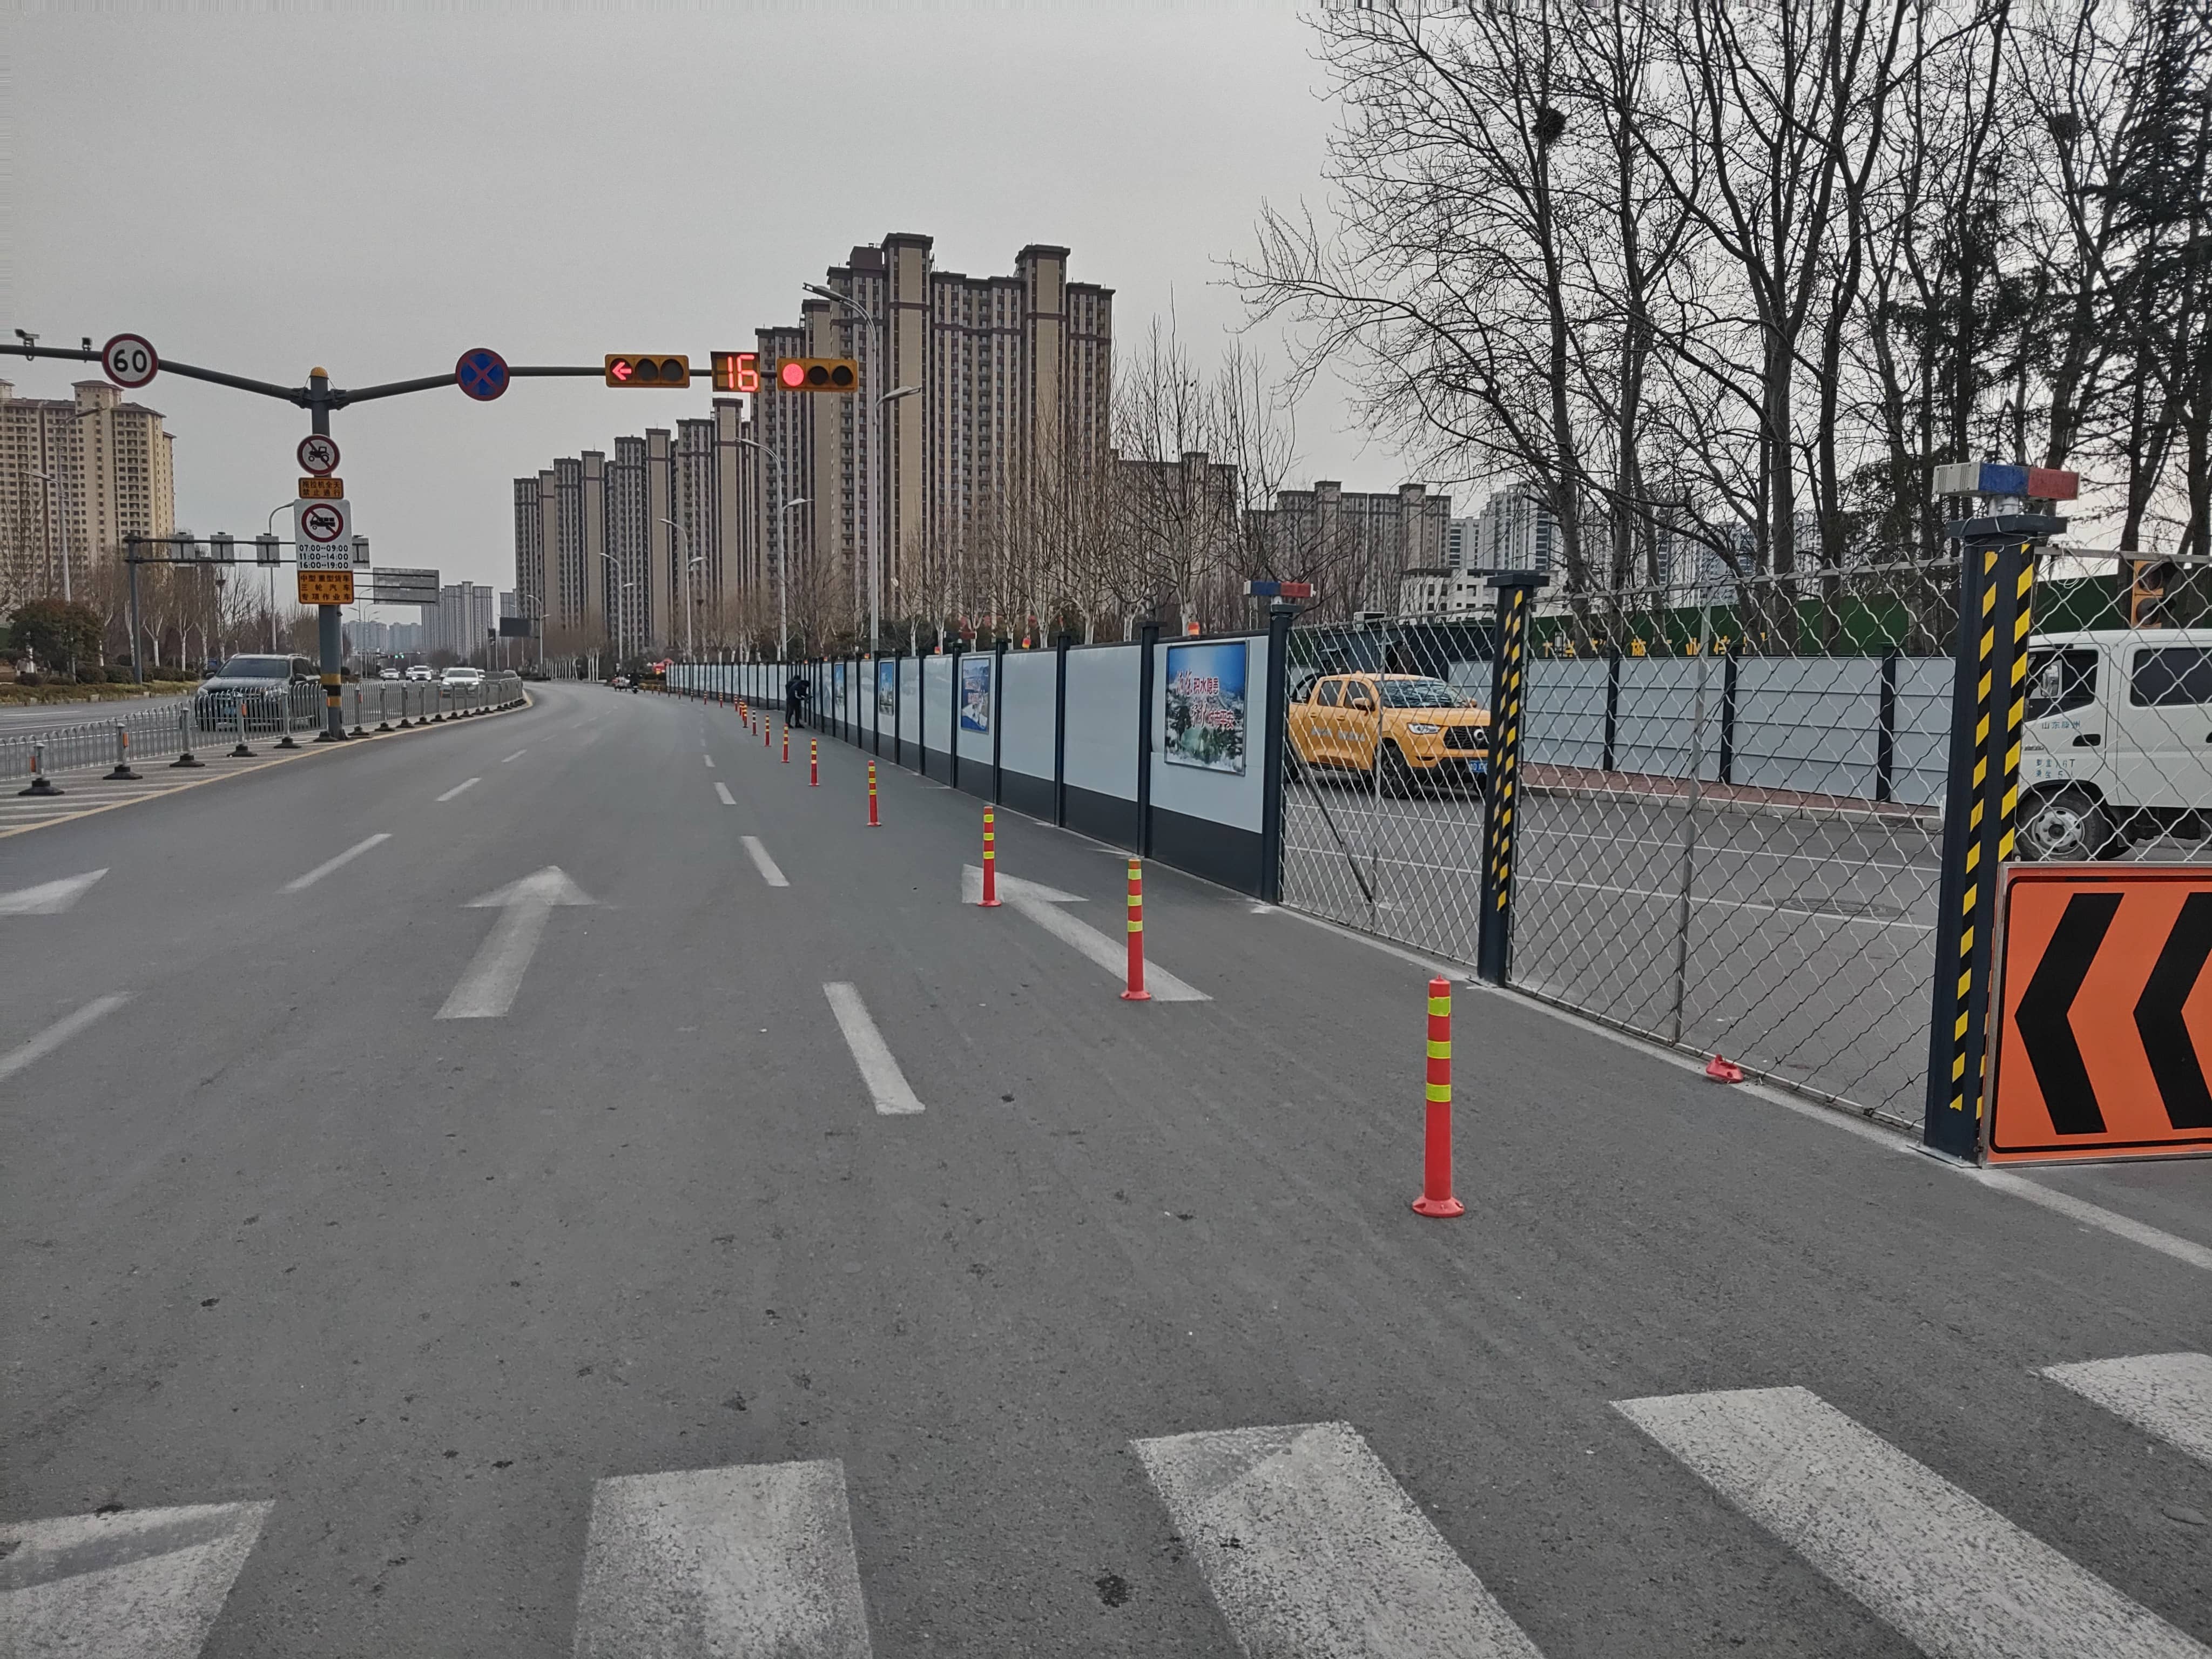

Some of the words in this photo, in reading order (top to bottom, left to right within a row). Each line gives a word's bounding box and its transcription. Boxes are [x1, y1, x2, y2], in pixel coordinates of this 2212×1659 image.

[114, 349, 147, 373] 60
[727, 354, 758, 391] 16
[303, 488, 341, 496] 禁止通行
